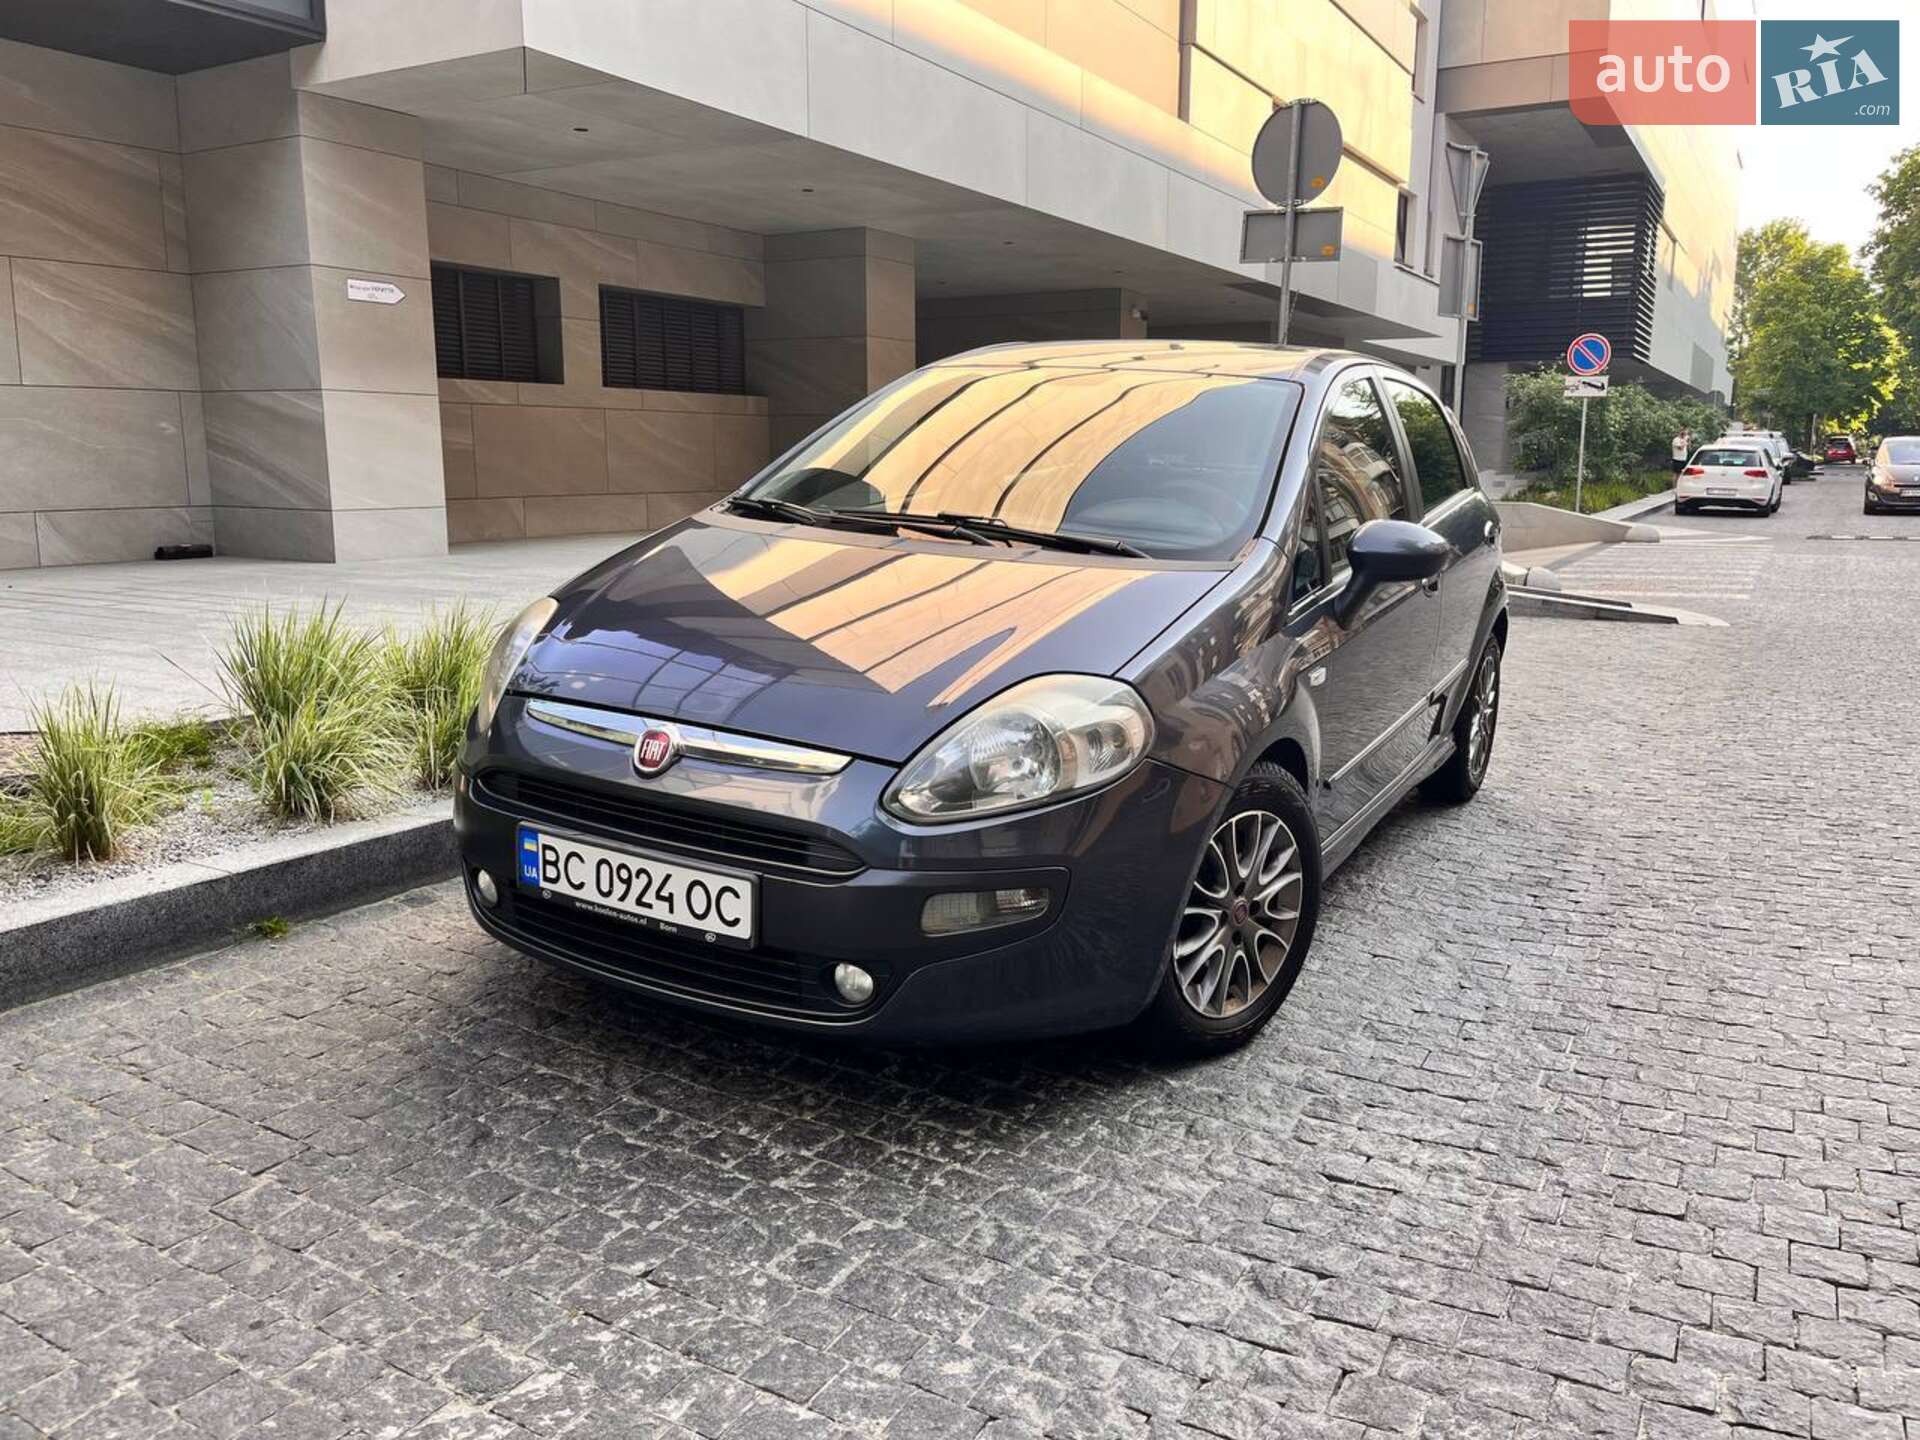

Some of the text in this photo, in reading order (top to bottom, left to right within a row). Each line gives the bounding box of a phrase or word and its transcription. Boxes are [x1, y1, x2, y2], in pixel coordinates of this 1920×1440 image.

[640, 738, 668, 761] FIAT
[523, 864, 538, 880] UA
[541, 843, 742, 928] BC 0924 OC
